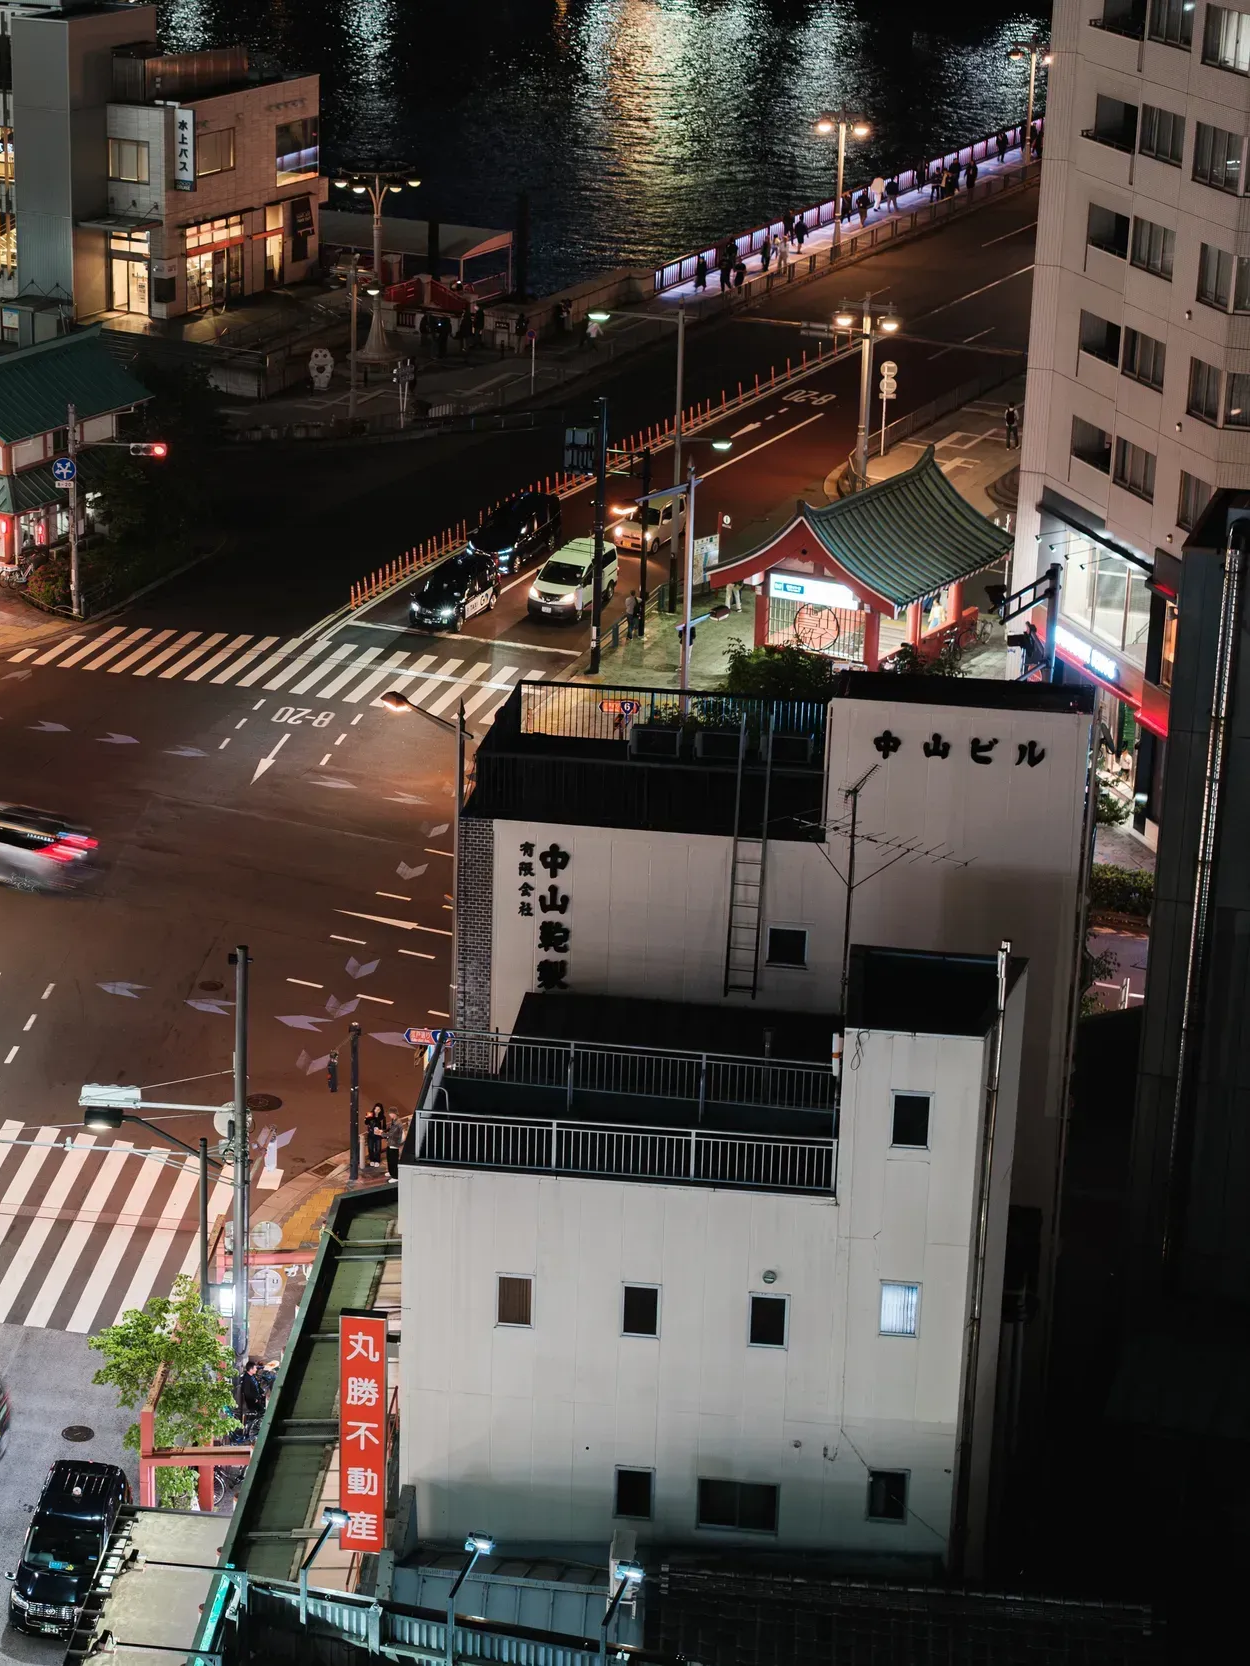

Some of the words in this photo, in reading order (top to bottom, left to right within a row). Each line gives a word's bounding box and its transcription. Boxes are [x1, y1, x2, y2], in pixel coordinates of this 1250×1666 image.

[178, 120, 188, 172] 水上バス
[783, 389, 837, 406] 8-20
[270, 706, 336, 728] 8-20
[872, 729, 1046, 768] 中山ビル
[518, 841, 535, 917] 有限会社
[537, 843, 570, 990] 中山鞄製
[346, 1332, 380, 1542] 丸勝不動産
